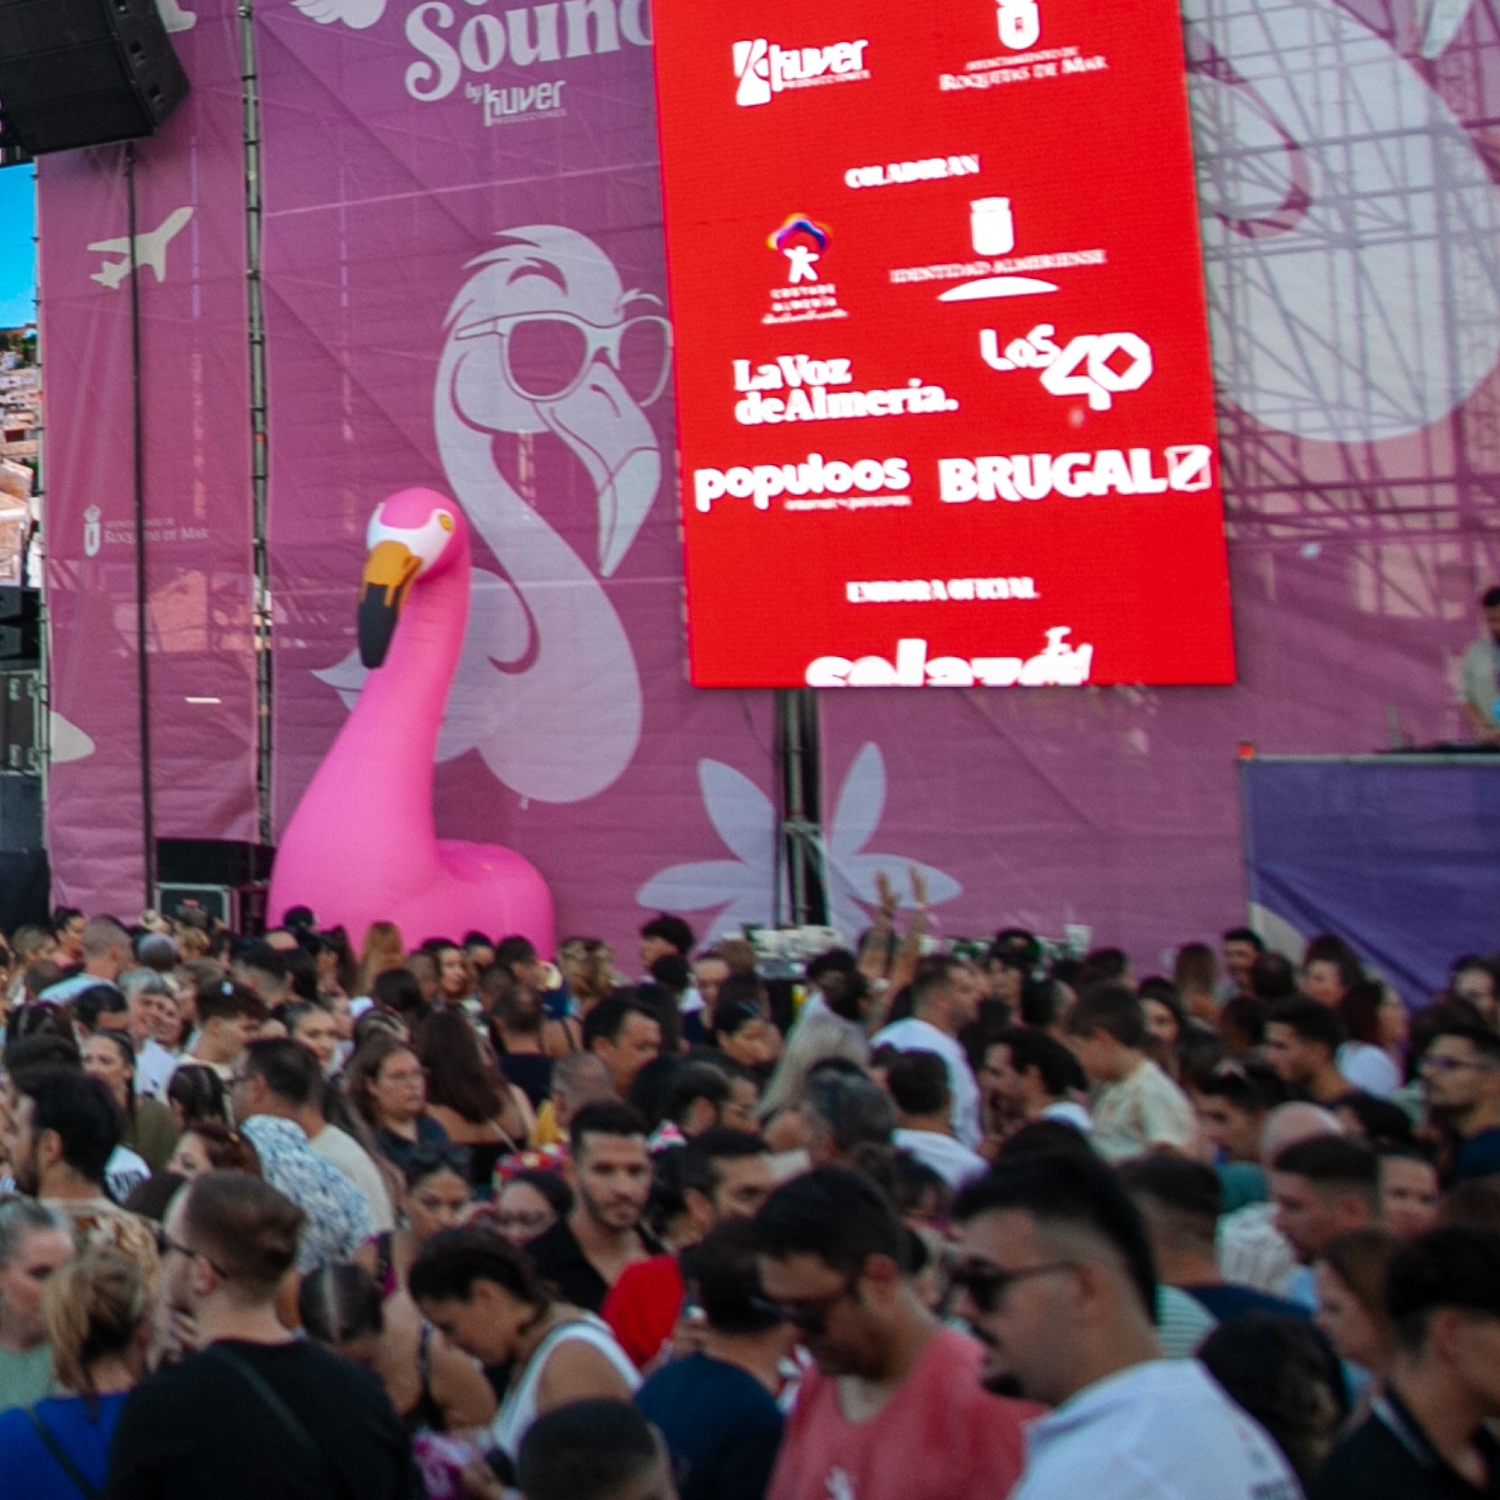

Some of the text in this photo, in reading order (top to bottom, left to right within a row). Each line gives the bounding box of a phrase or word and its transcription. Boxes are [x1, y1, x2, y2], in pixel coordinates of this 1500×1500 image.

[1039, 332, 1153, 411] 40
[694, 453, 911, 513] populoos
[938, 448, 1168, 504] BRUGAL
